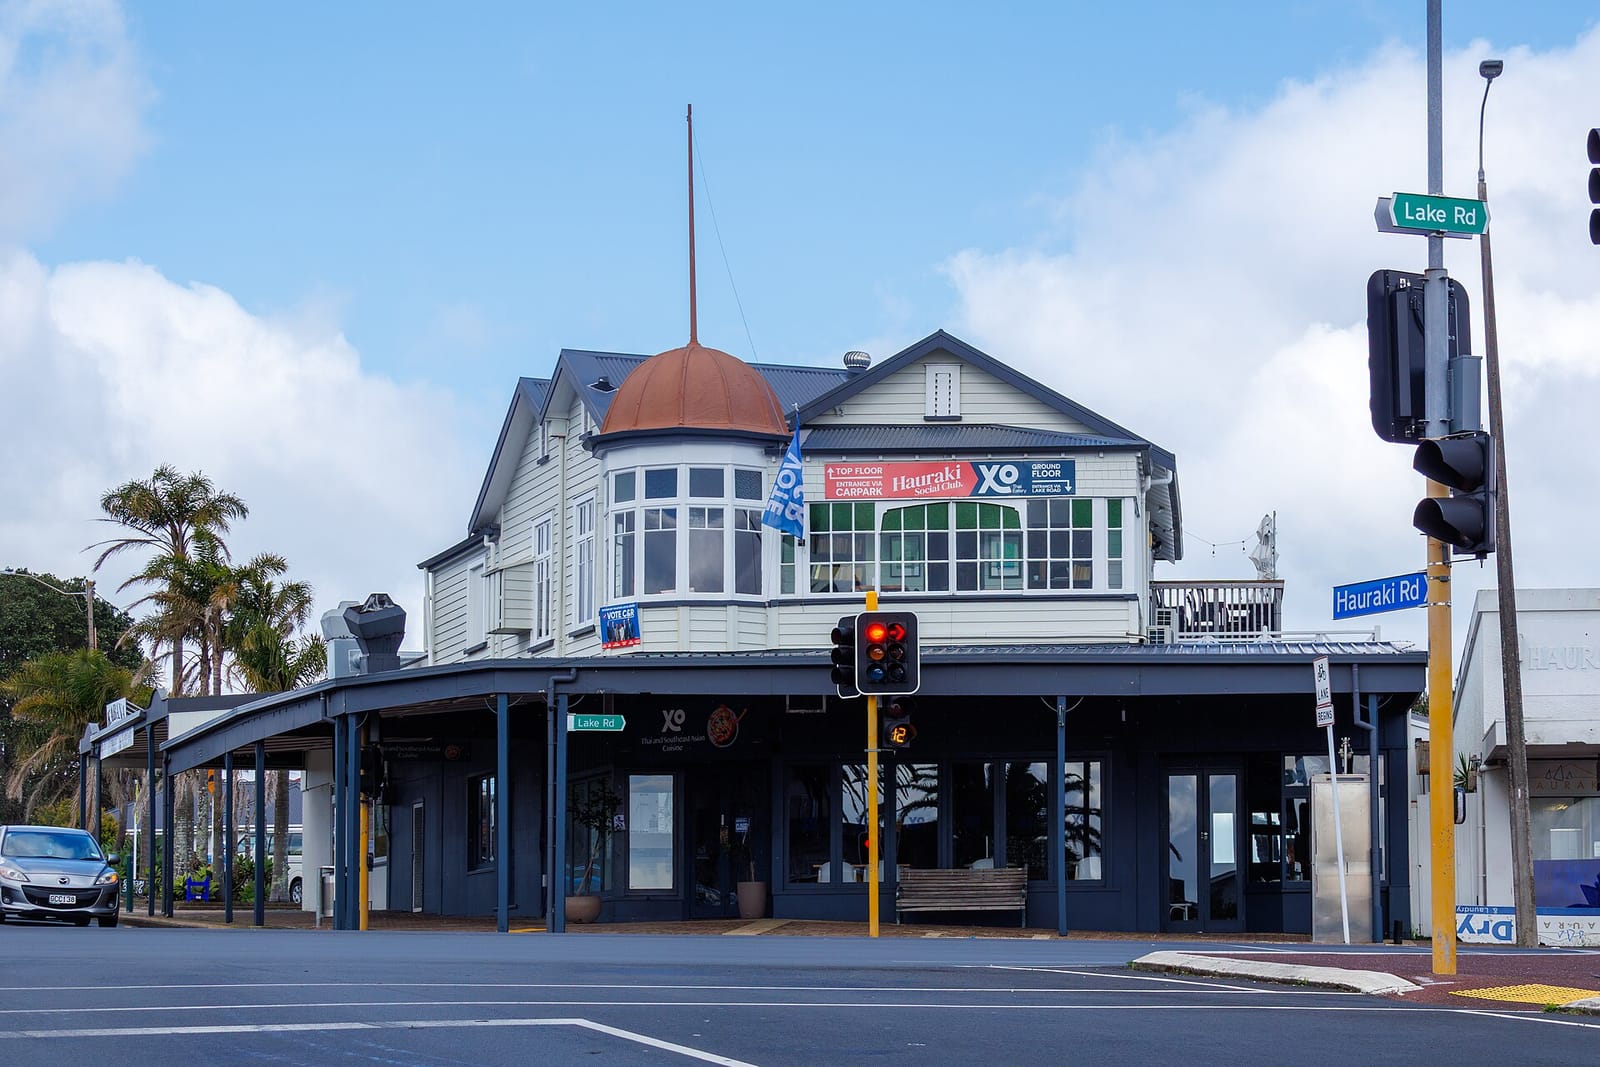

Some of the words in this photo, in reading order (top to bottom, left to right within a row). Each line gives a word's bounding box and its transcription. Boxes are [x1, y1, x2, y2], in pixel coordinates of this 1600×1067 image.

[1405, 202, 1447, 223] Lake
[1454, 206, 1476, 226] Rd
[836, 467, 853, 475] TOP
[855, 467, 883, 475] FLOOR
[892, 463, 961, 492] Hauraki
[1031, 470, 1061, 478] FLOOR
[766, 452, 802, 517] VOTE
[978, 464, 1019, 494] XO
[836, 487, 883, 497] CARPARK
[914, 485, 940, 496] Social
[1337, 582, 1395, 613] Hauraki
[1400, 577, 1419, 603] Rd
[607, 610, 622, 620] VOTE
[1317, 687, 1329, 701] LANE
[661, 709, 686, 733] XO
[1317, 710, 1333, 722] BEGINS
[578, 718, 599, 728] Lake
[603, 718, 615, 728] Rd
[1456, 906, 1489, 914] Laundry
[1457, 914, 1513, 941] Dry
